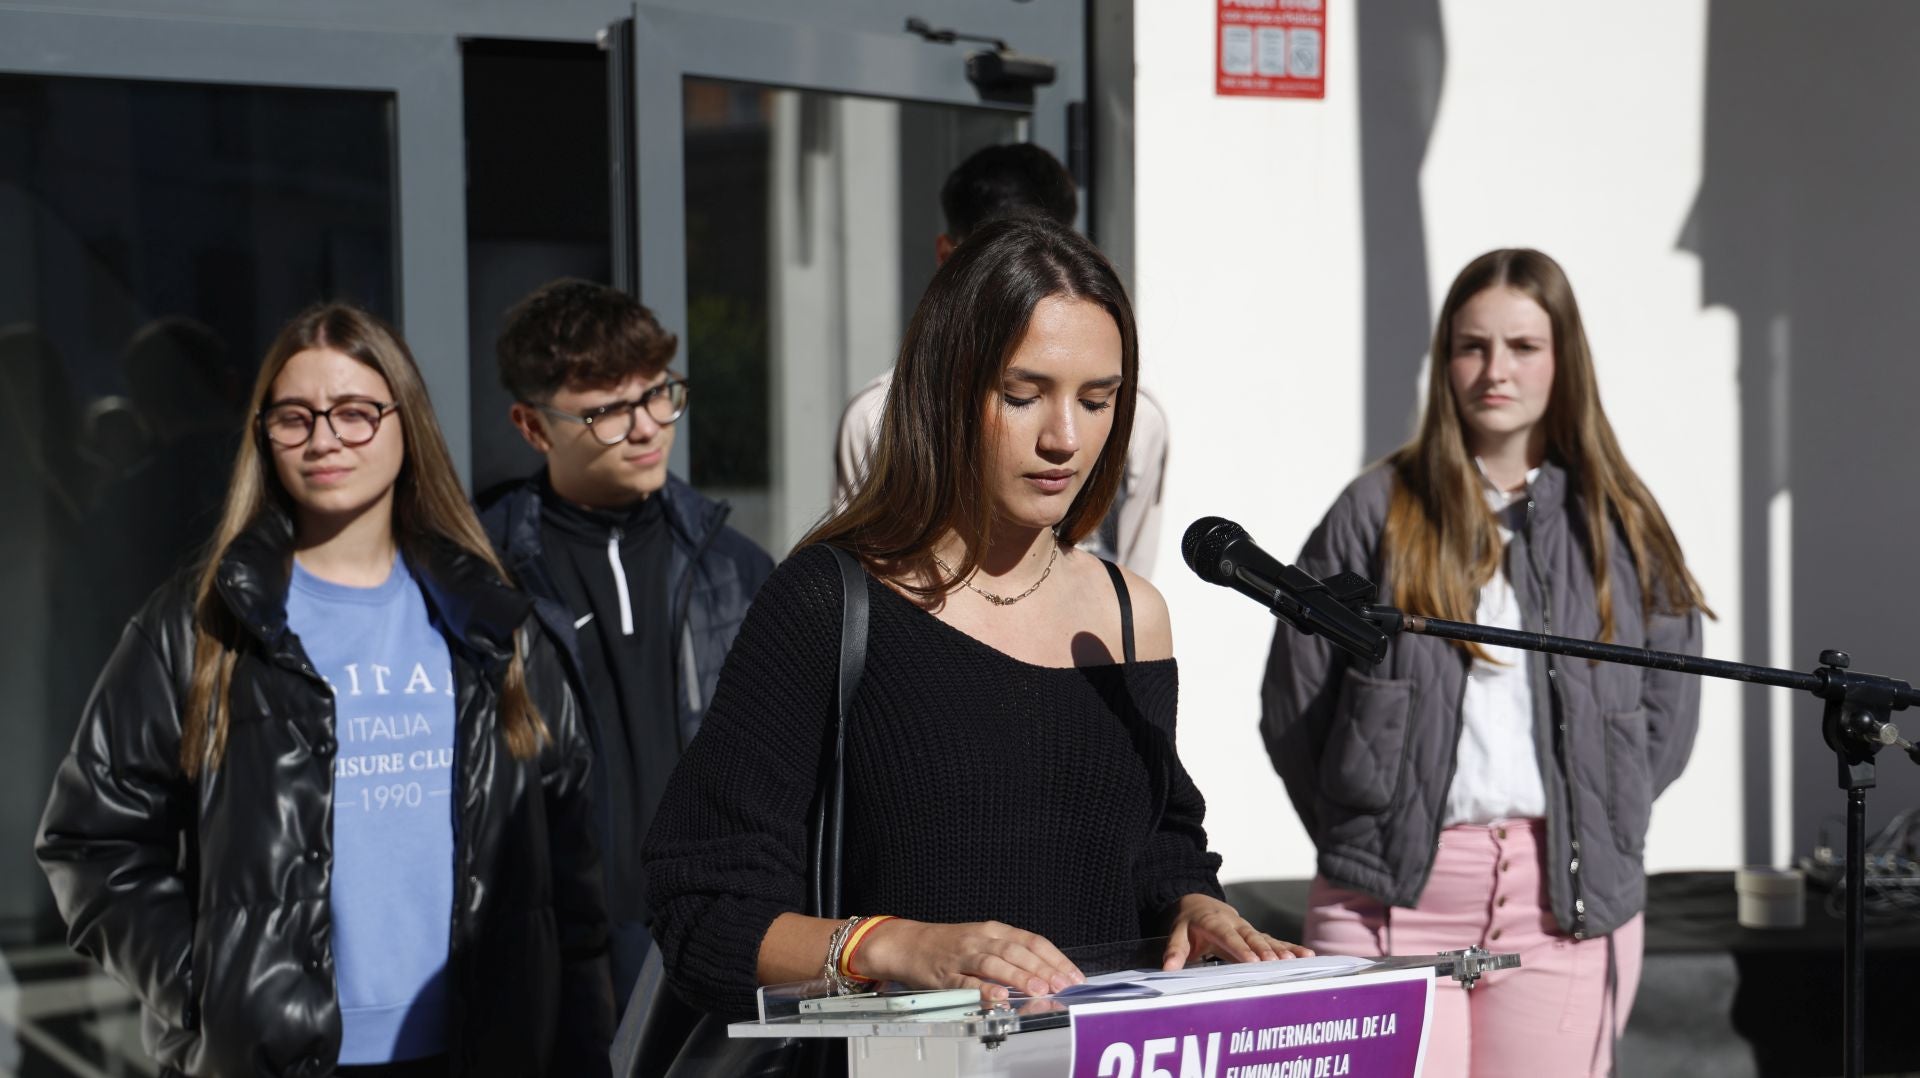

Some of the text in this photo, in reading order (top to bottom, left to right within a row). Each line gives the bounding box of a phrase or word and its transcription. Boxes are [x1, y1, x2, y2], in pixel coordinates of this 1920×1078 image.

[349, 713, 431, 742] ITALIA
[361, 782, 421, 812] 1990
[1229, 1013, 1396, 1054] DÍA INTERNACIONAL DE LA
[1314, 1056, 1332, 1078] DE
[1333, 1054, 1349, 1075] LA
